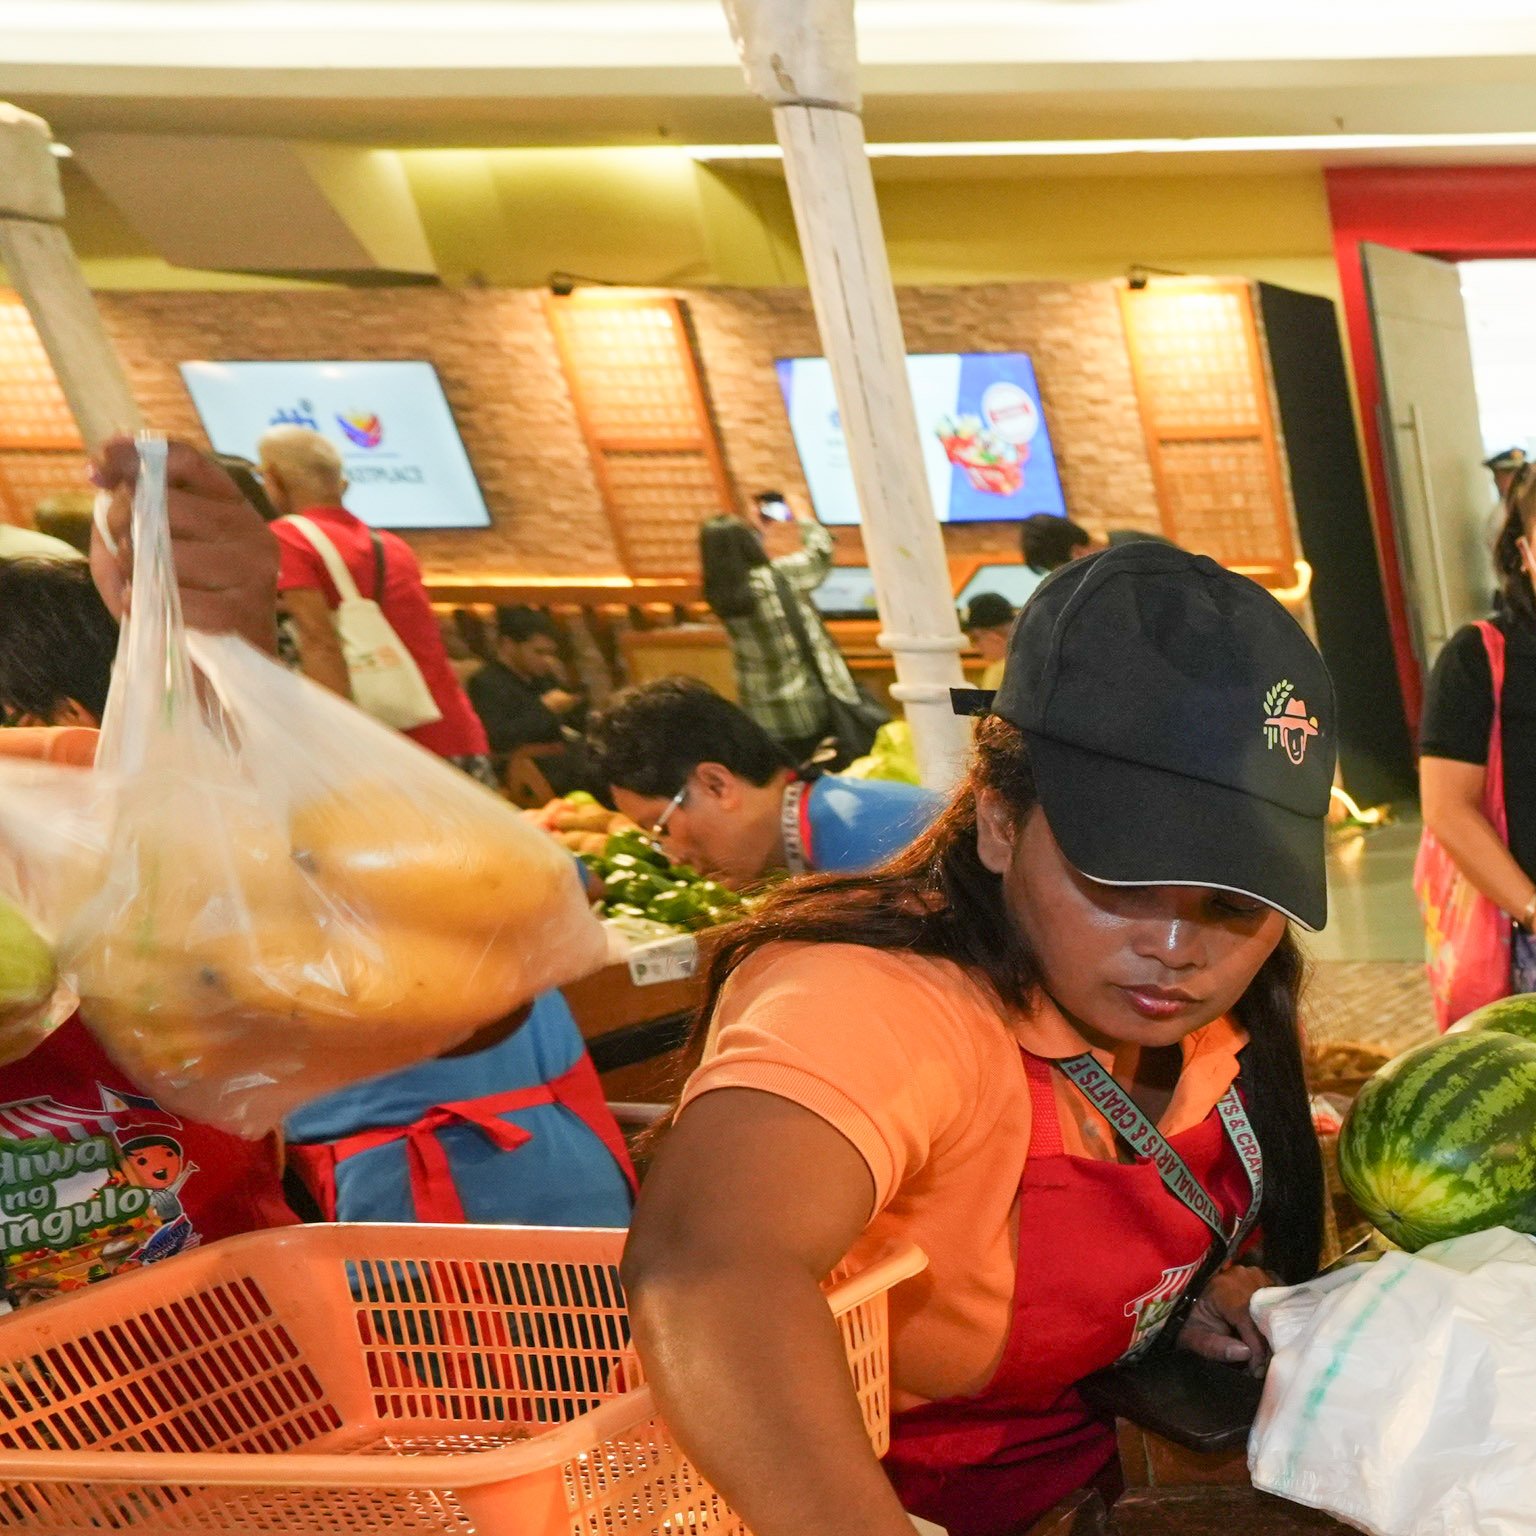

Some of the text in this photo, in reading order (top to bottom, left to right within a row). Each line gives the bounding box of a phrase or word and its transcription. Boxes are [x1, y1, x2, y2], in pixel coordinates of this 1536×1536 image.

[1079, 1073, 1138, 1130] CRAFTS
[1130, 1121, 1149, 1142] &
[1228, 1119, 1246, 1131] &
[1142, 1135, 1181, 1177] ARTS
[5, 1185, 50, 1210] ng
[1173, 1172, 1222, 1228] ATIONAL
[0, 1188, 145, 1250] ngulo
